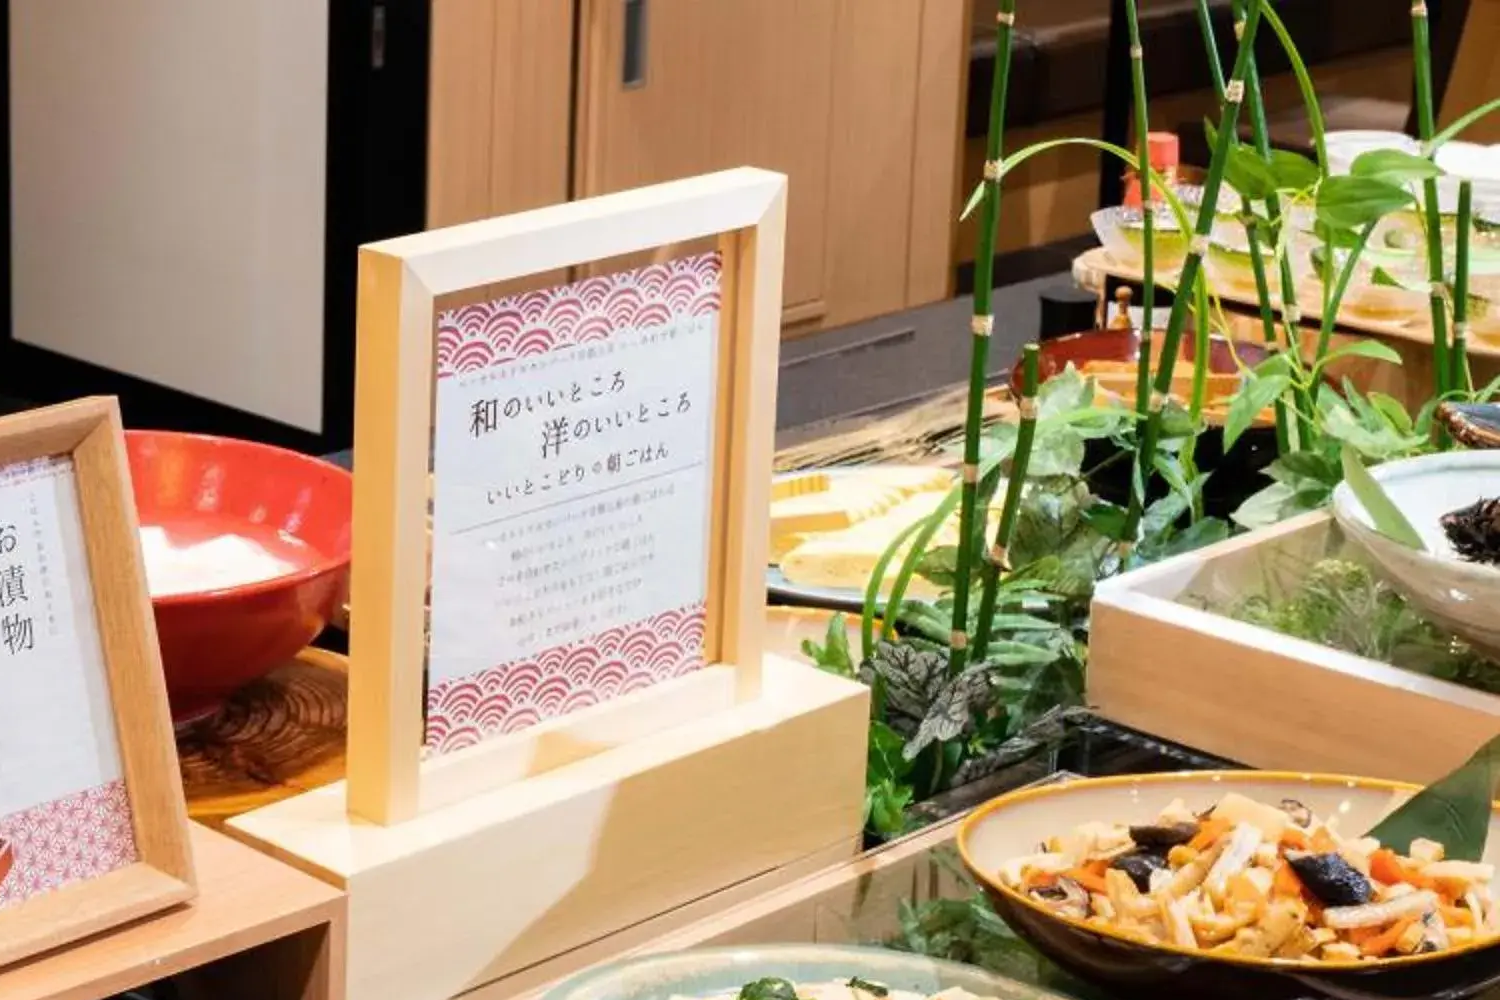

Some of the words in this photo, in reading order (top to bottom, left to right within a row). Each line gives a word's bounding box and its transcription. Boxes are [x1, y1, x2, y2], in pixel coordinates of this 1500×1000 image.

[469, 370, 626, 439] 和のいいところ
[541, 391, 693, 459] 洋のいいところ
[486, 442, 669, 505] いいとこどりの朝ごはん
